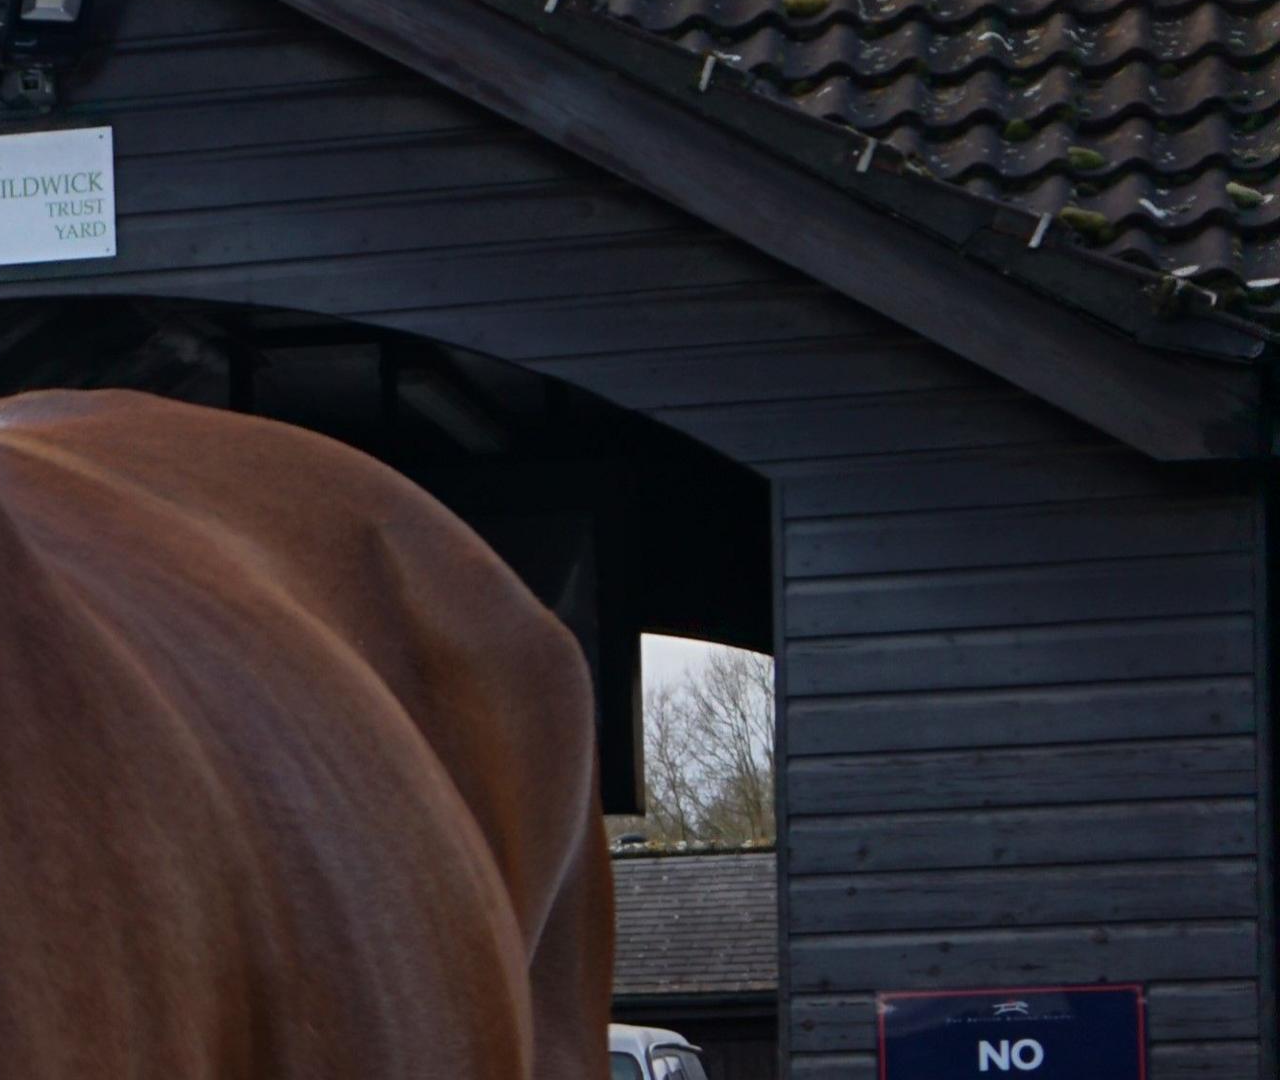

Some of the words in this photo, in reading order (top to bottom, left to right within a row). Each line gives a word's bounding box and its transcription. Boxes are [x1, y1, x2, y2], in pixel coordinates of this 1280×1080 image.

[45, 199, 105, 219] TRUST
[54, 221, 107, 241] YARD
[979, 1038, 1044, 1072] NO
